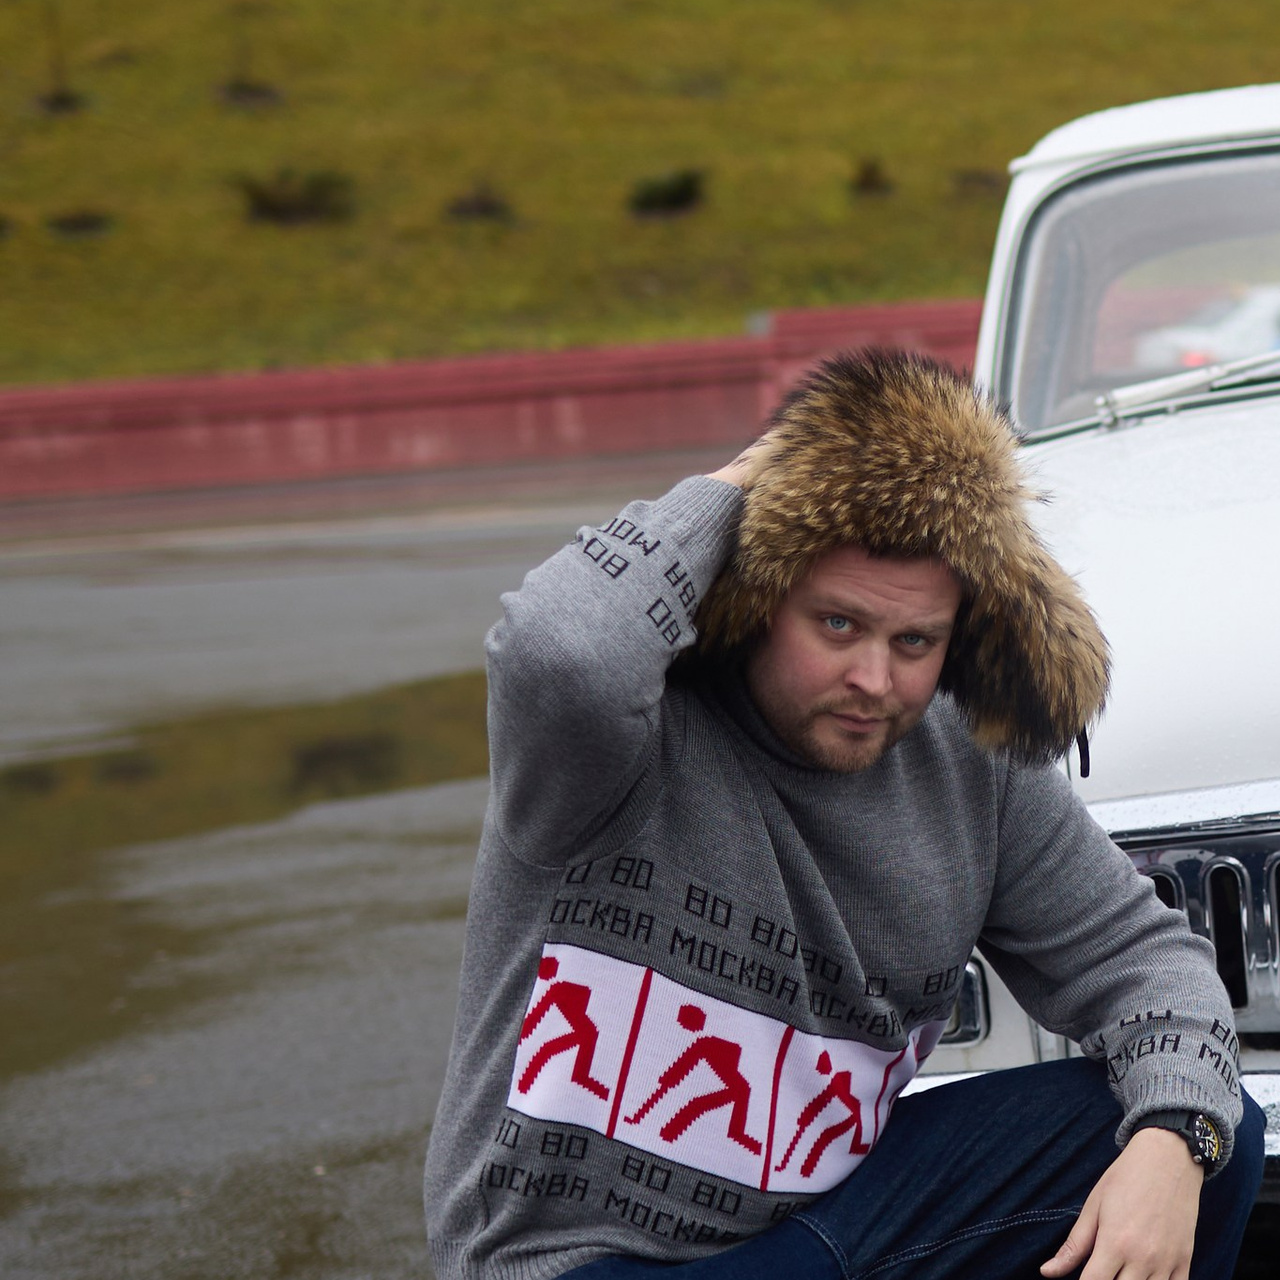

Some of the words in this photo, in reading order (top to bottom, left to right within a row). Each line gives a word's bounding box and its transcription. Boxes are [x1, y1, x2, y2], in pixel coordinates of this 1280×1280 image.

[550, 899, 655, 944] ОСКВА
[670, 925, 800, 1005] МОСКВА
[809, 990, 903, 1038] ОСКВА
[480, 1162, 590, 1203] ОСКВА
